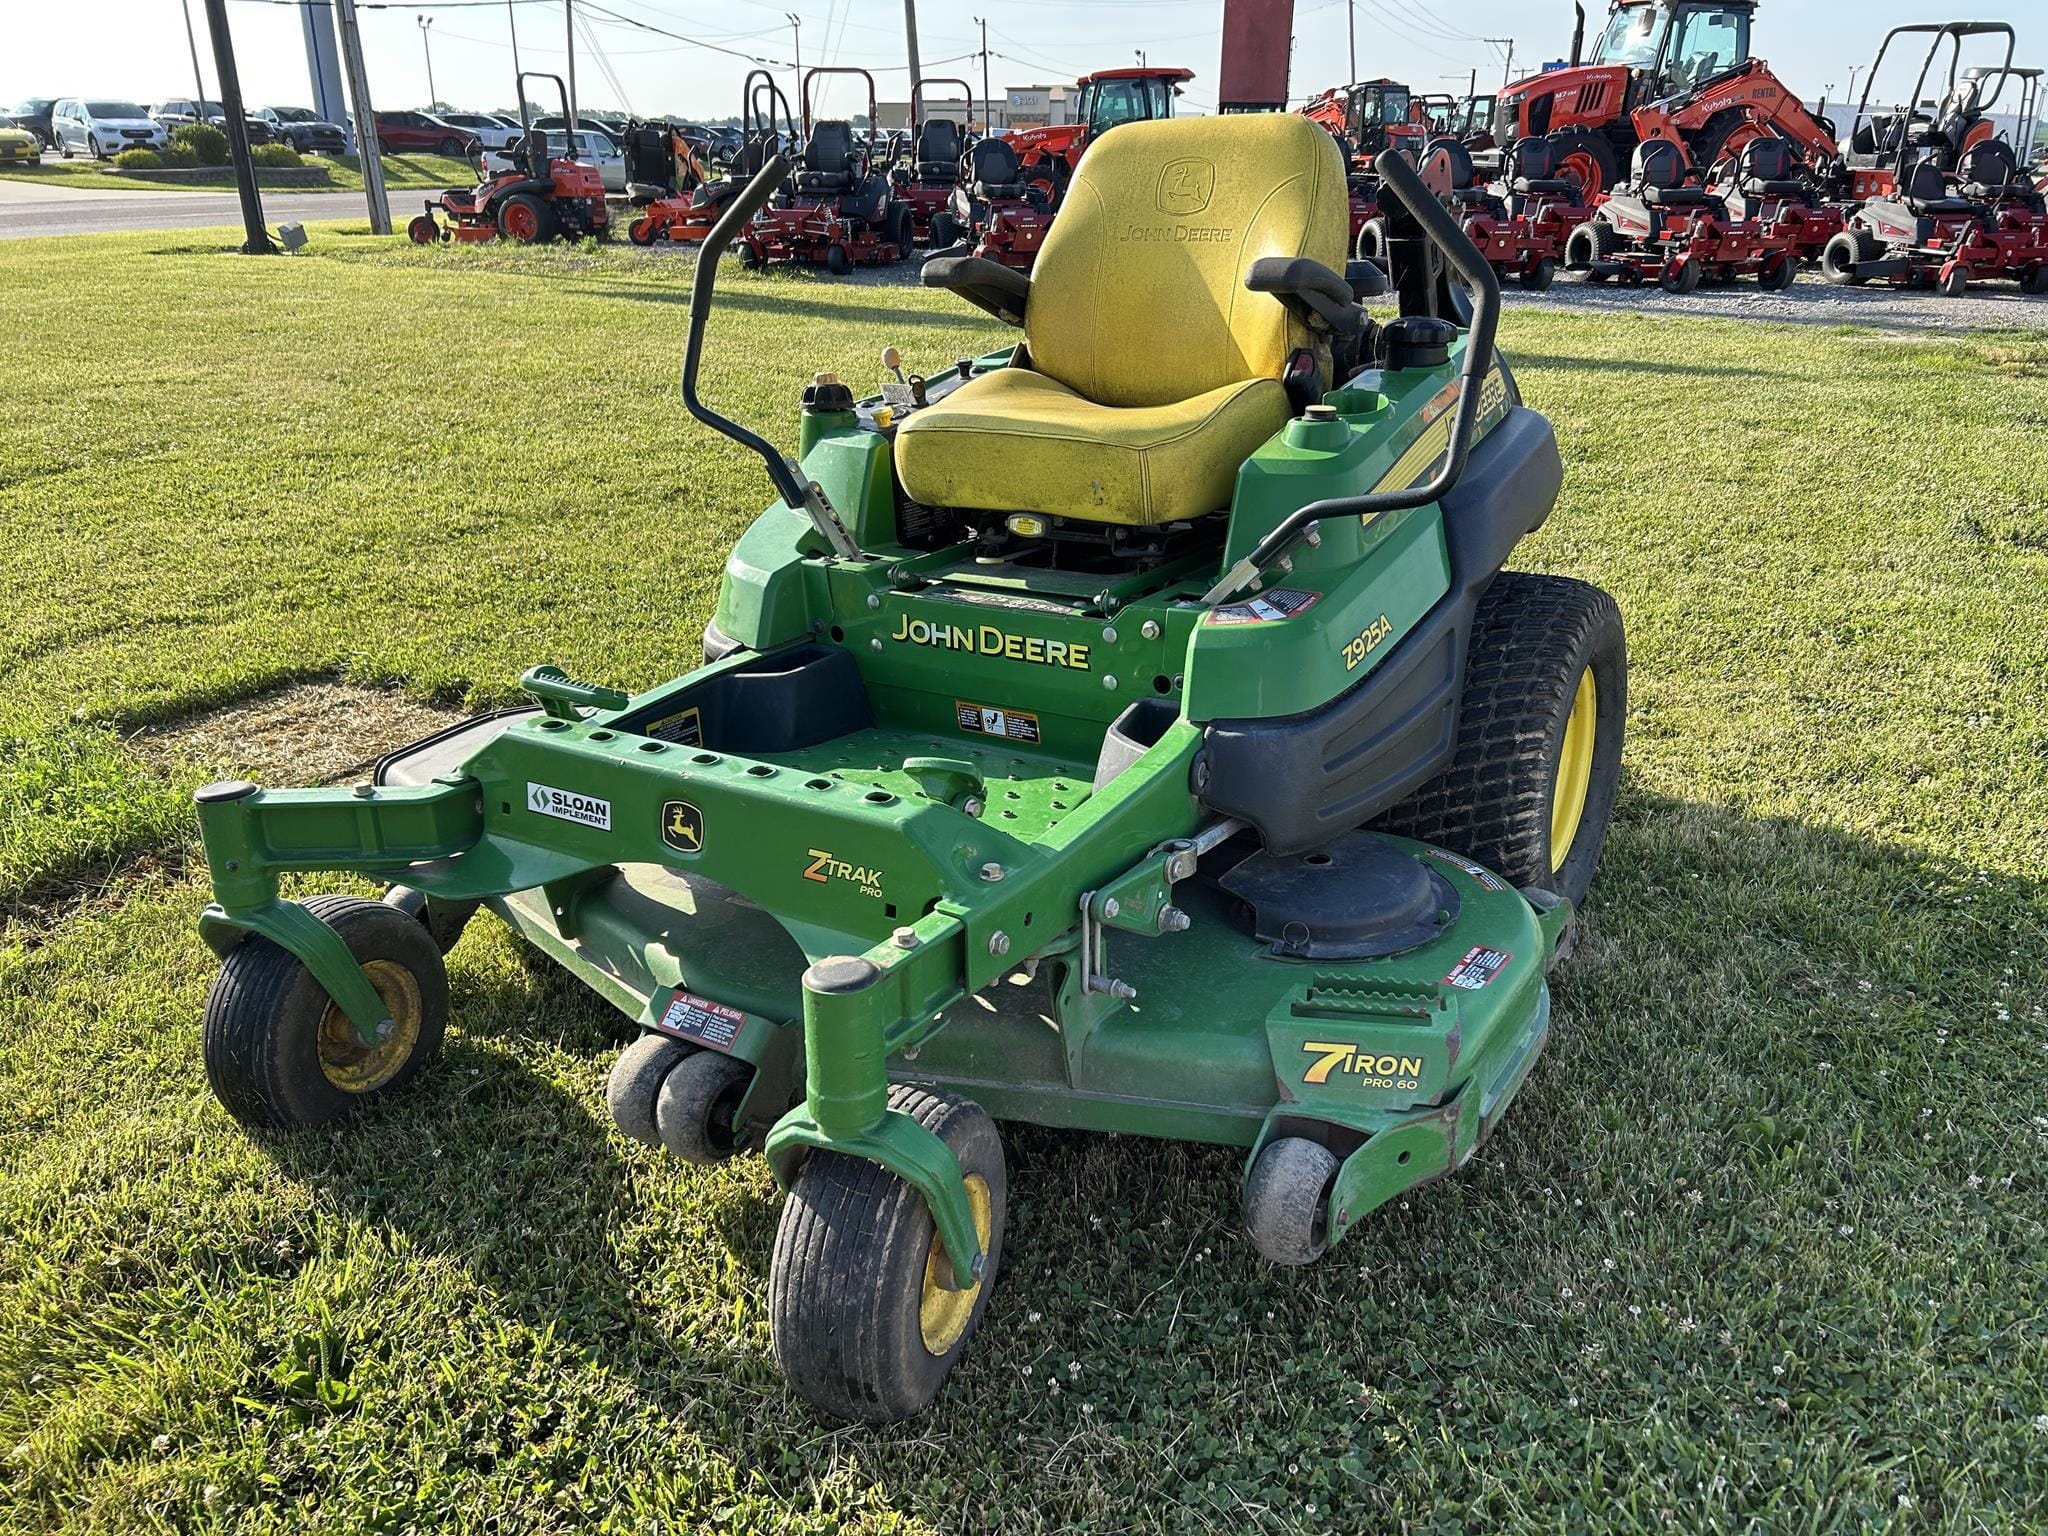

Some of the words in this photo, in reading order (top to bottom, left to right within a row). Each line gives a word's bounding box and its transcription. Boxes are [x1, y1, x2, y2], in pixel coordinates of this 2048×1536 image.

[1751, 87, 1777, 99] RENTAL
[1701, 97, 1732, 112] Kubota
[1022, 133, 1047, 141] Kubota
[1120, 225, 1172, 242] JOHN
[1174, 225, 1233, 243] DEERE
[892, 613, 975, 652] JOHN
[979, 625, 1090, 670] DEERE
[1341, 613, 1393, 671] Z925A
[551, 792, 607, 817] SLOAN
[552, 805, 607, 826] IMPLEMENT
[859, 885, 883, 898] PRO
[1362, 1077, 1394, 1088] PRO
[1396, 1080, 1418, 1090] 60
